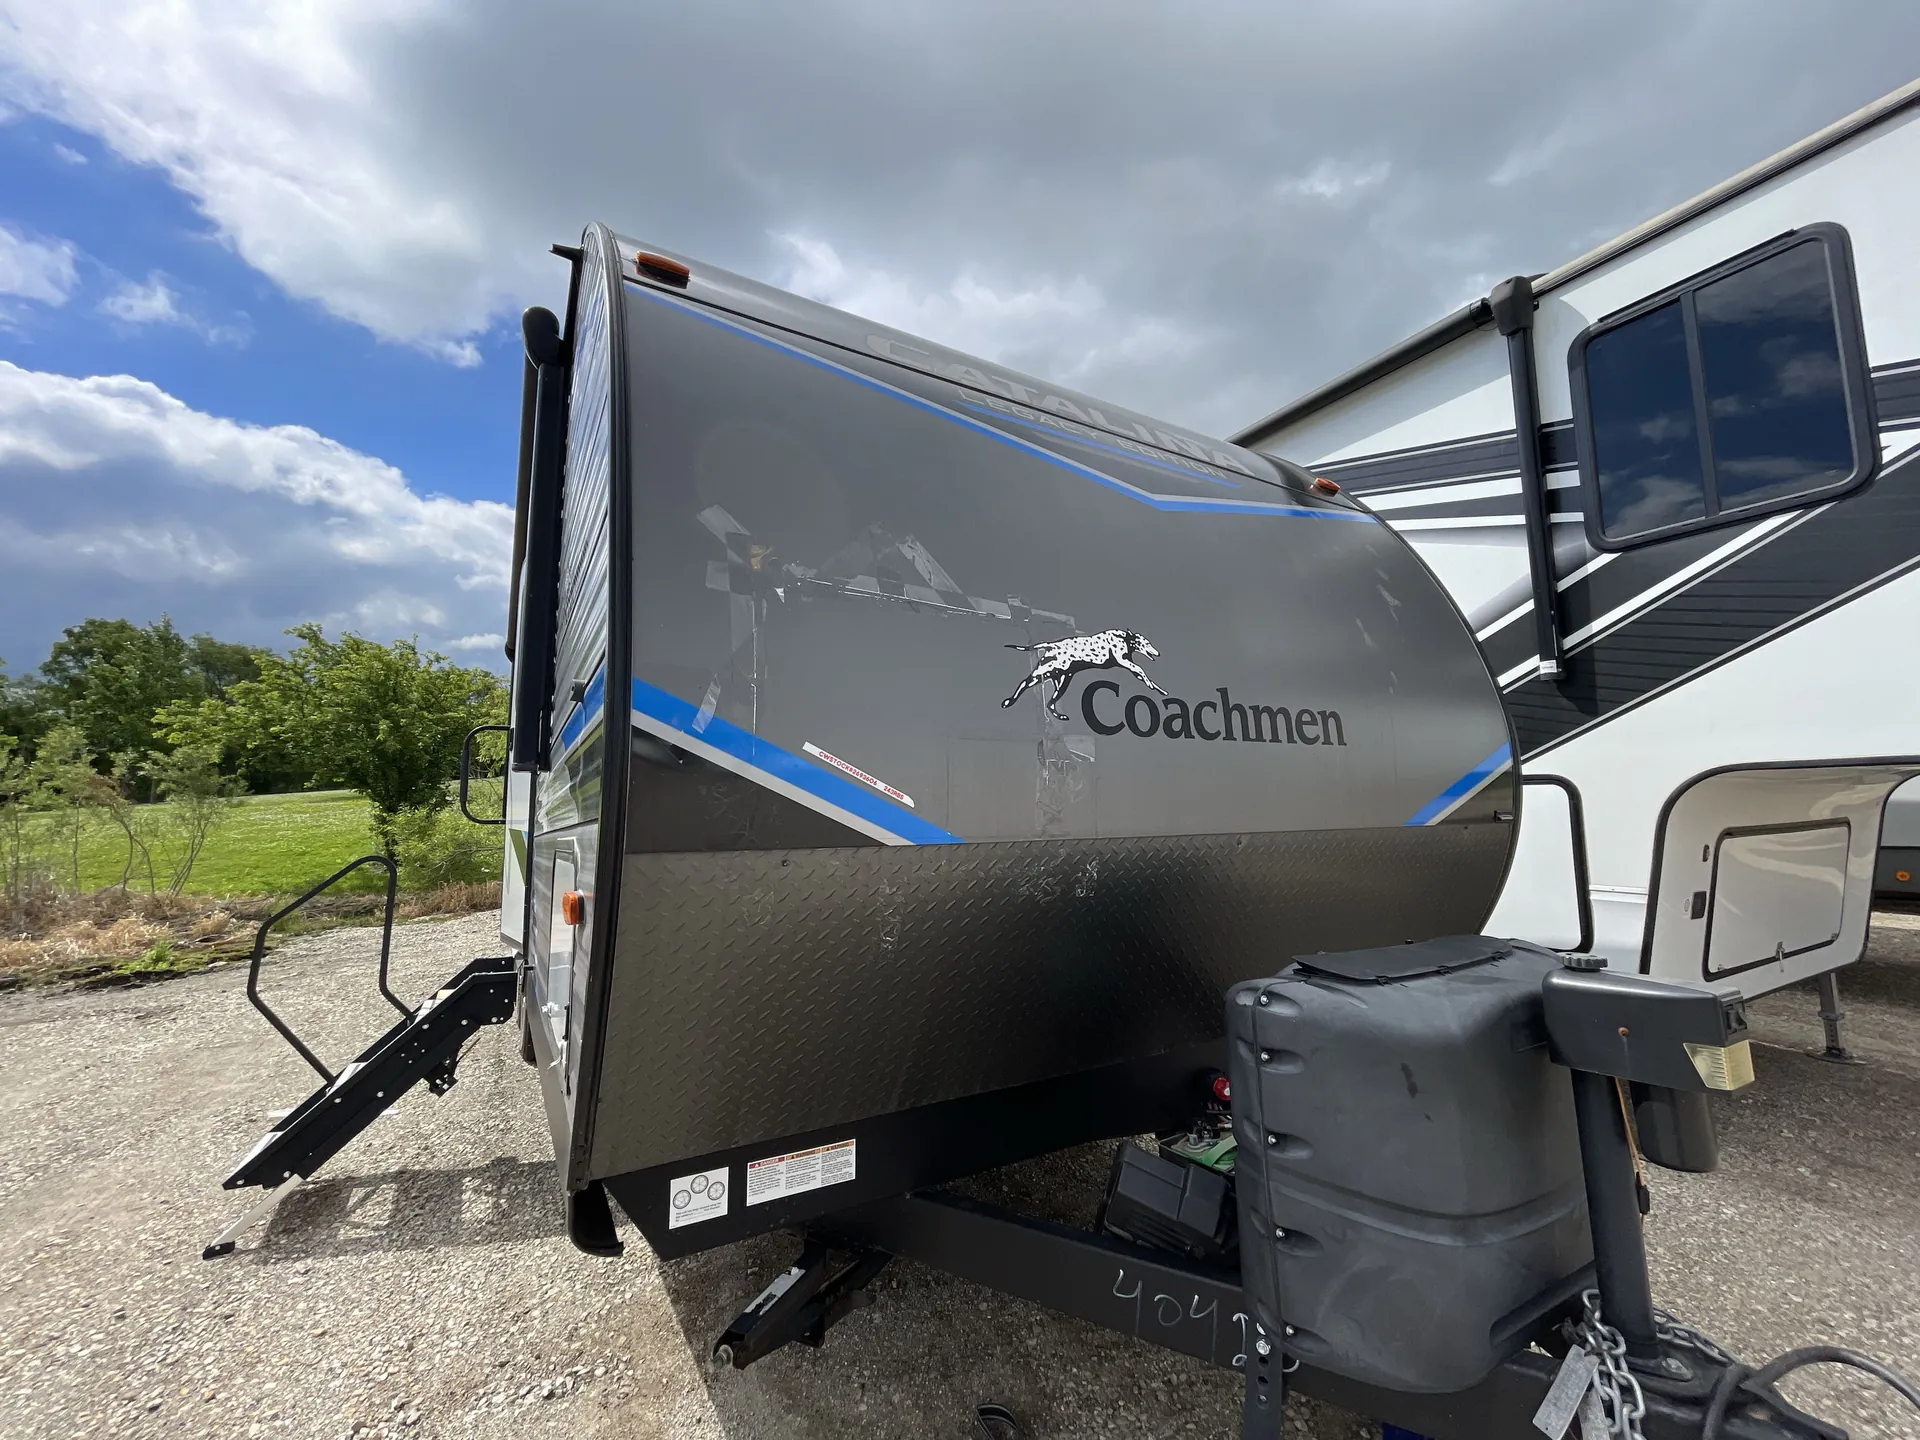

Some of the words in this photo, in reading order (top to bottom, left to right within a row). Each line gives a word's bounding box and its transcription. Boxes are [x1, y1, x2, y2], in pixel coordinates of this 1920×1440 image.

[866, 334, 1256, 476] CATALINA
[958, 387, 1098, 440] LEGACY
[1116, 438, 1228, 480] EDITION
[1081, 679, 1347, 747] Coachmen
